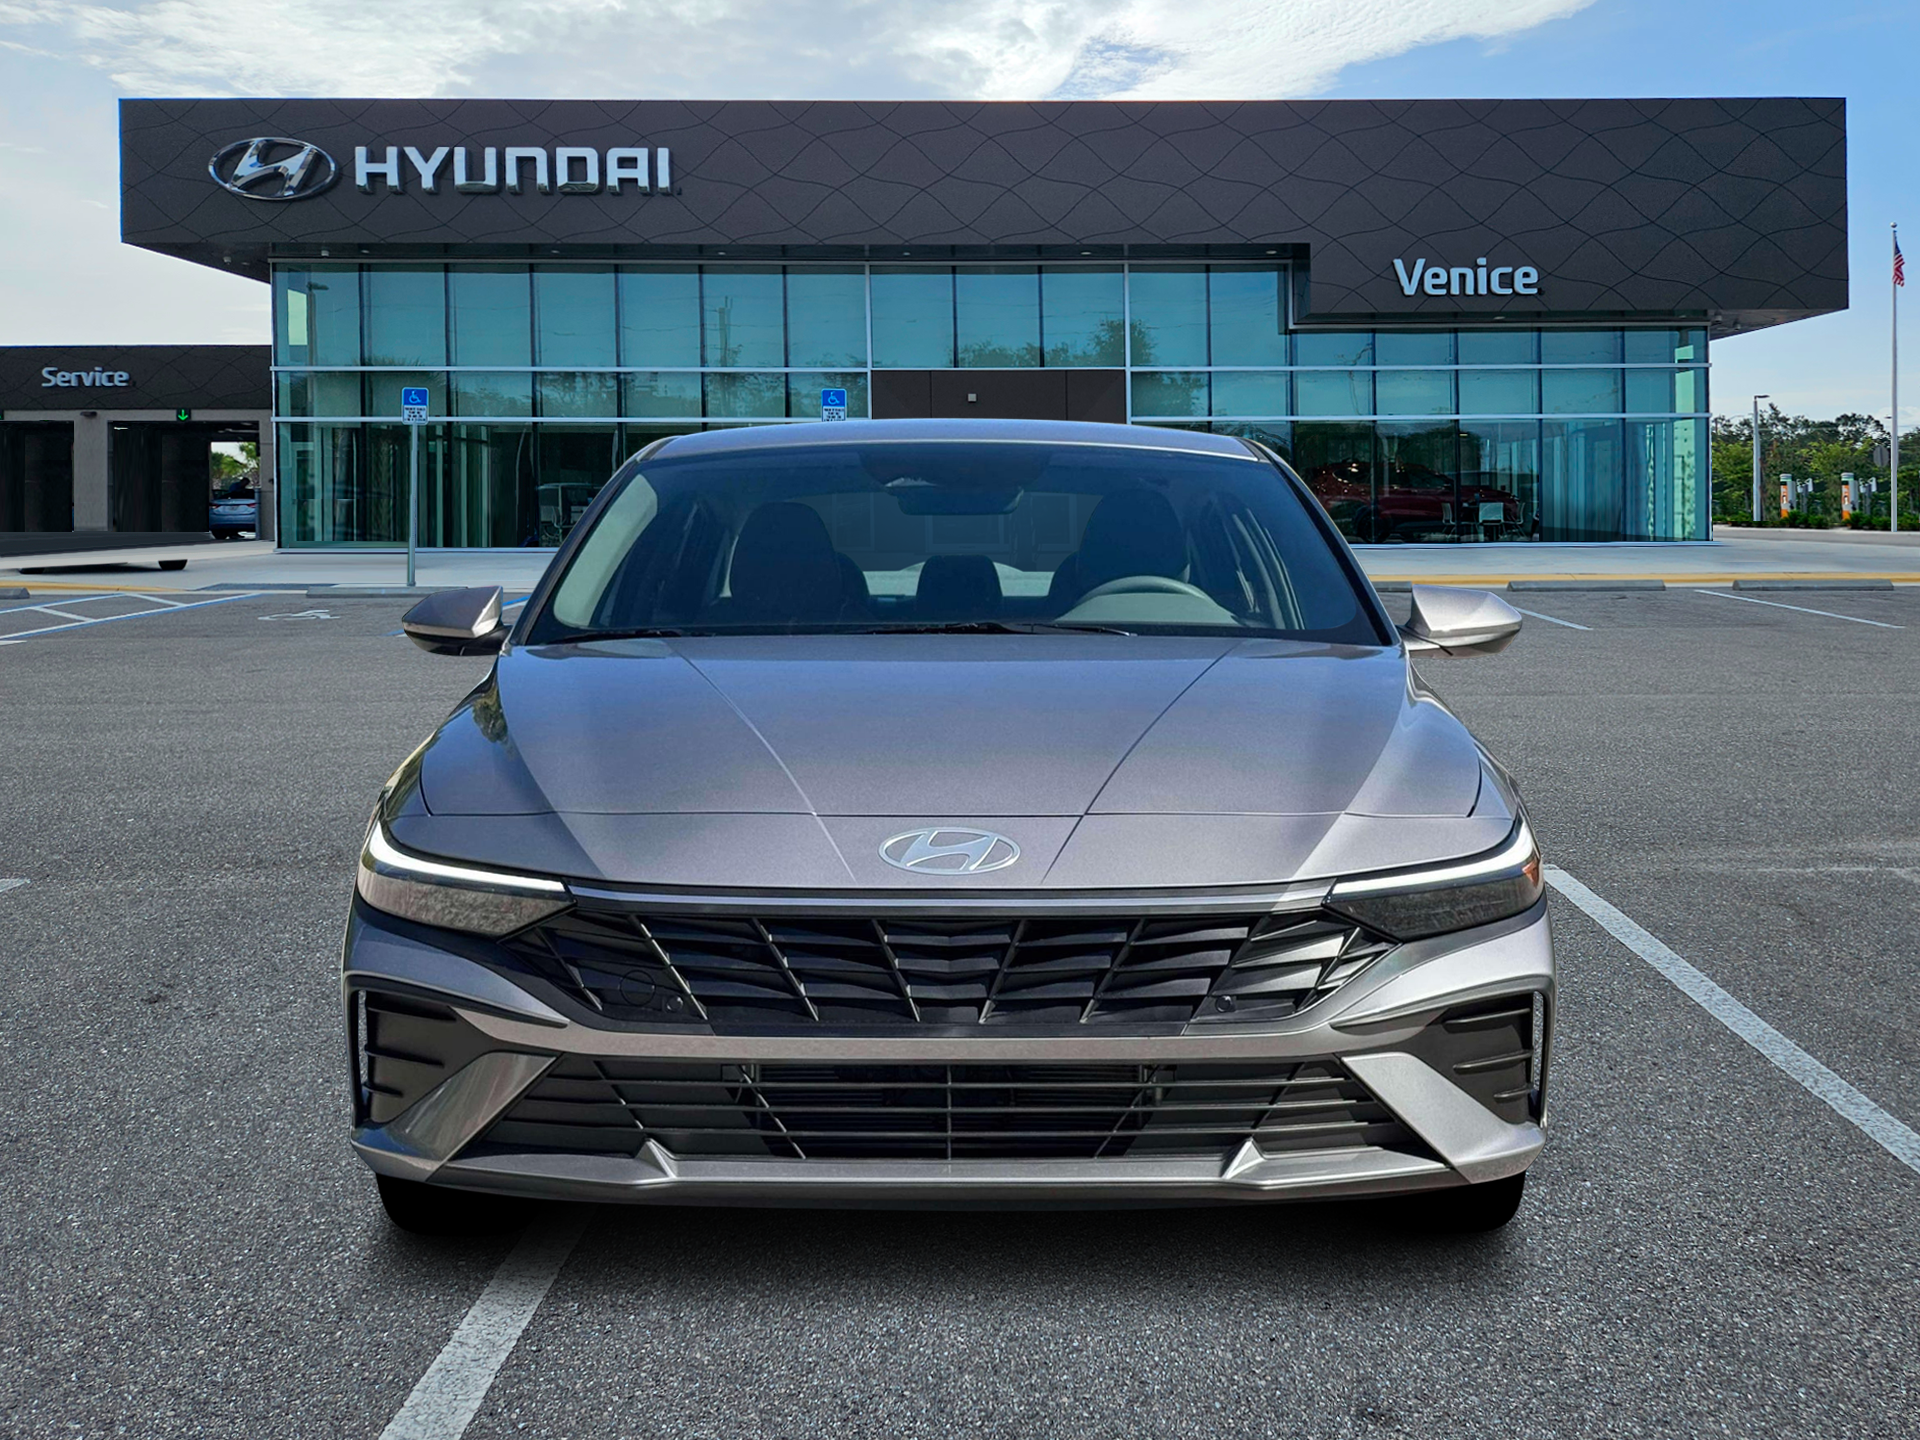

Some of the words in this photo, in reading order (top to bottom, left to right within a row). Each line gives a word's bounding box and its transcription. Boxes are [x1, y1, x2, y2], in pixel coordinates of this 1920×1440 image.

[355, 146, 671, 194] HYUNDAI
[1393, 257, 1539, 296] Venice
[41, 366, 130, 387] Service
